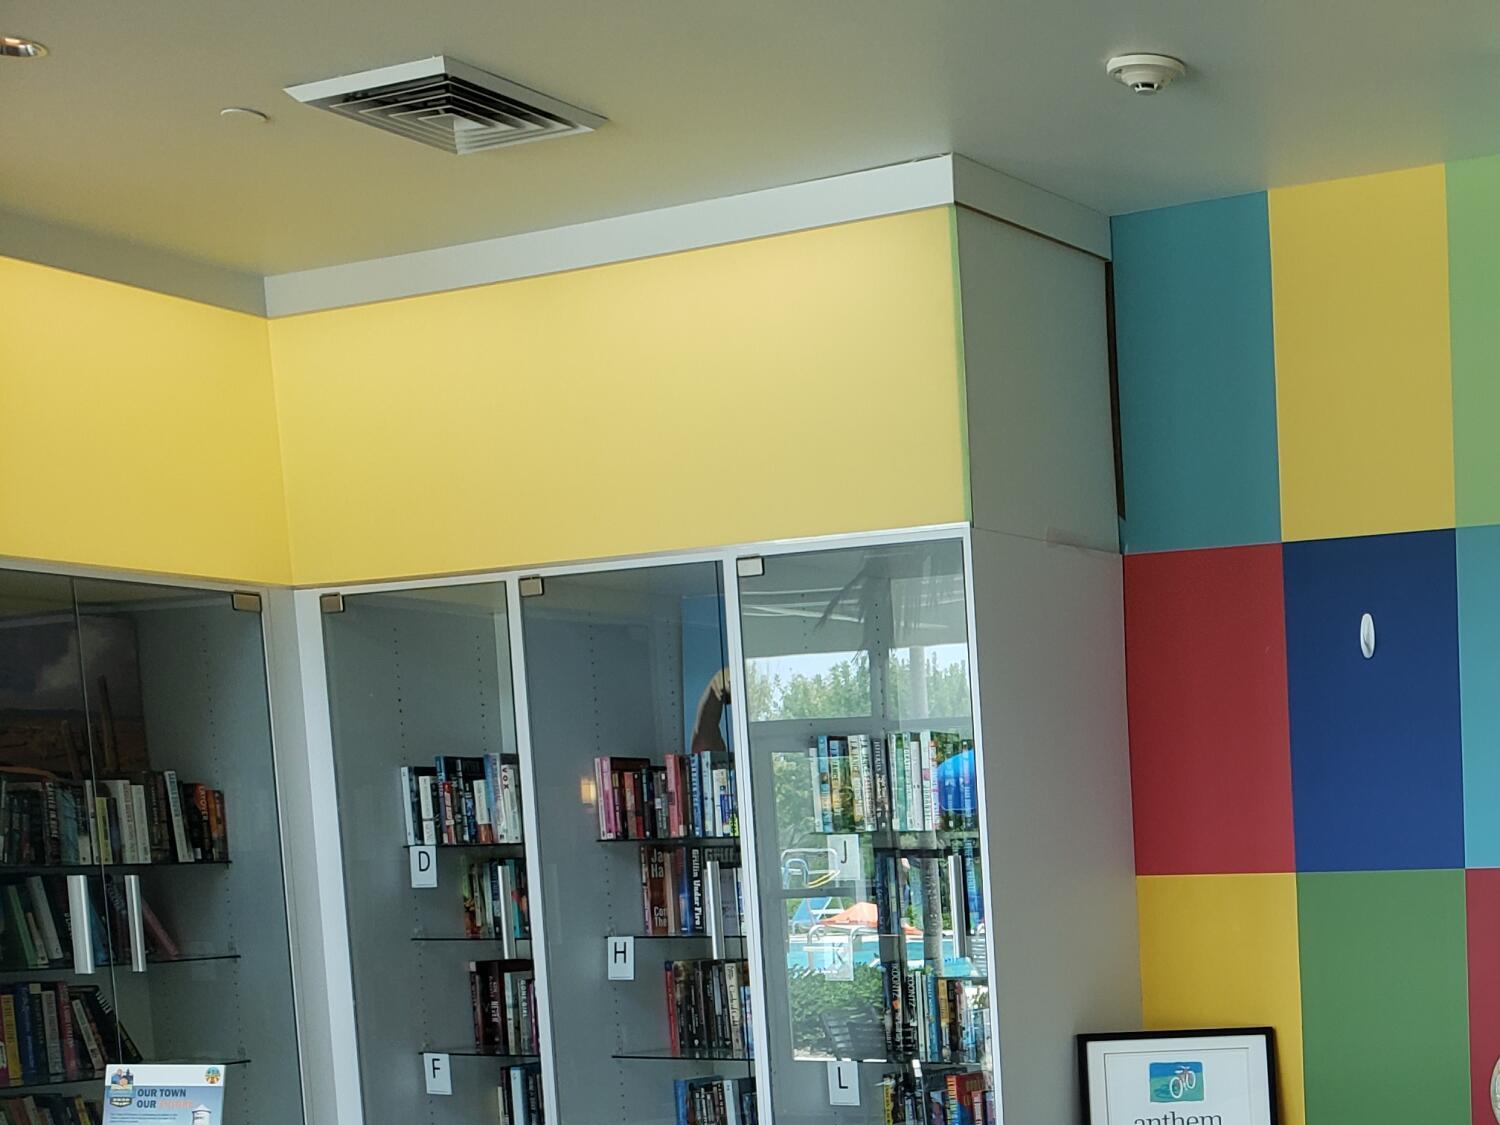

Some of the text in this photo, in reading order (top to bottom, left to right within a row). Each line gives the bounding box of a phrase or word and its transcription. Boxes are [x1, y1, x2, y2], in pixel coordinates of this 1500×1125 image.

[502, 767, 510, 790] VOX
[418, 851, 430, 872] D
[841, 840, 848, 864] J
[693, 880, 703, 906] Under
[693, 907, 703, 925] Fire
[614, 942, 627, 964] H
[891, 967, 900, 998] KOONTZ
[907, 976, 917, 1007] KOONTZ
[431, 1058, 441, 1079] F
[837, 1066, 848, 1089] L
[136, 1100, 156, 1108] OUR
[137, 1089, 186, 1097] OUR TOWN
